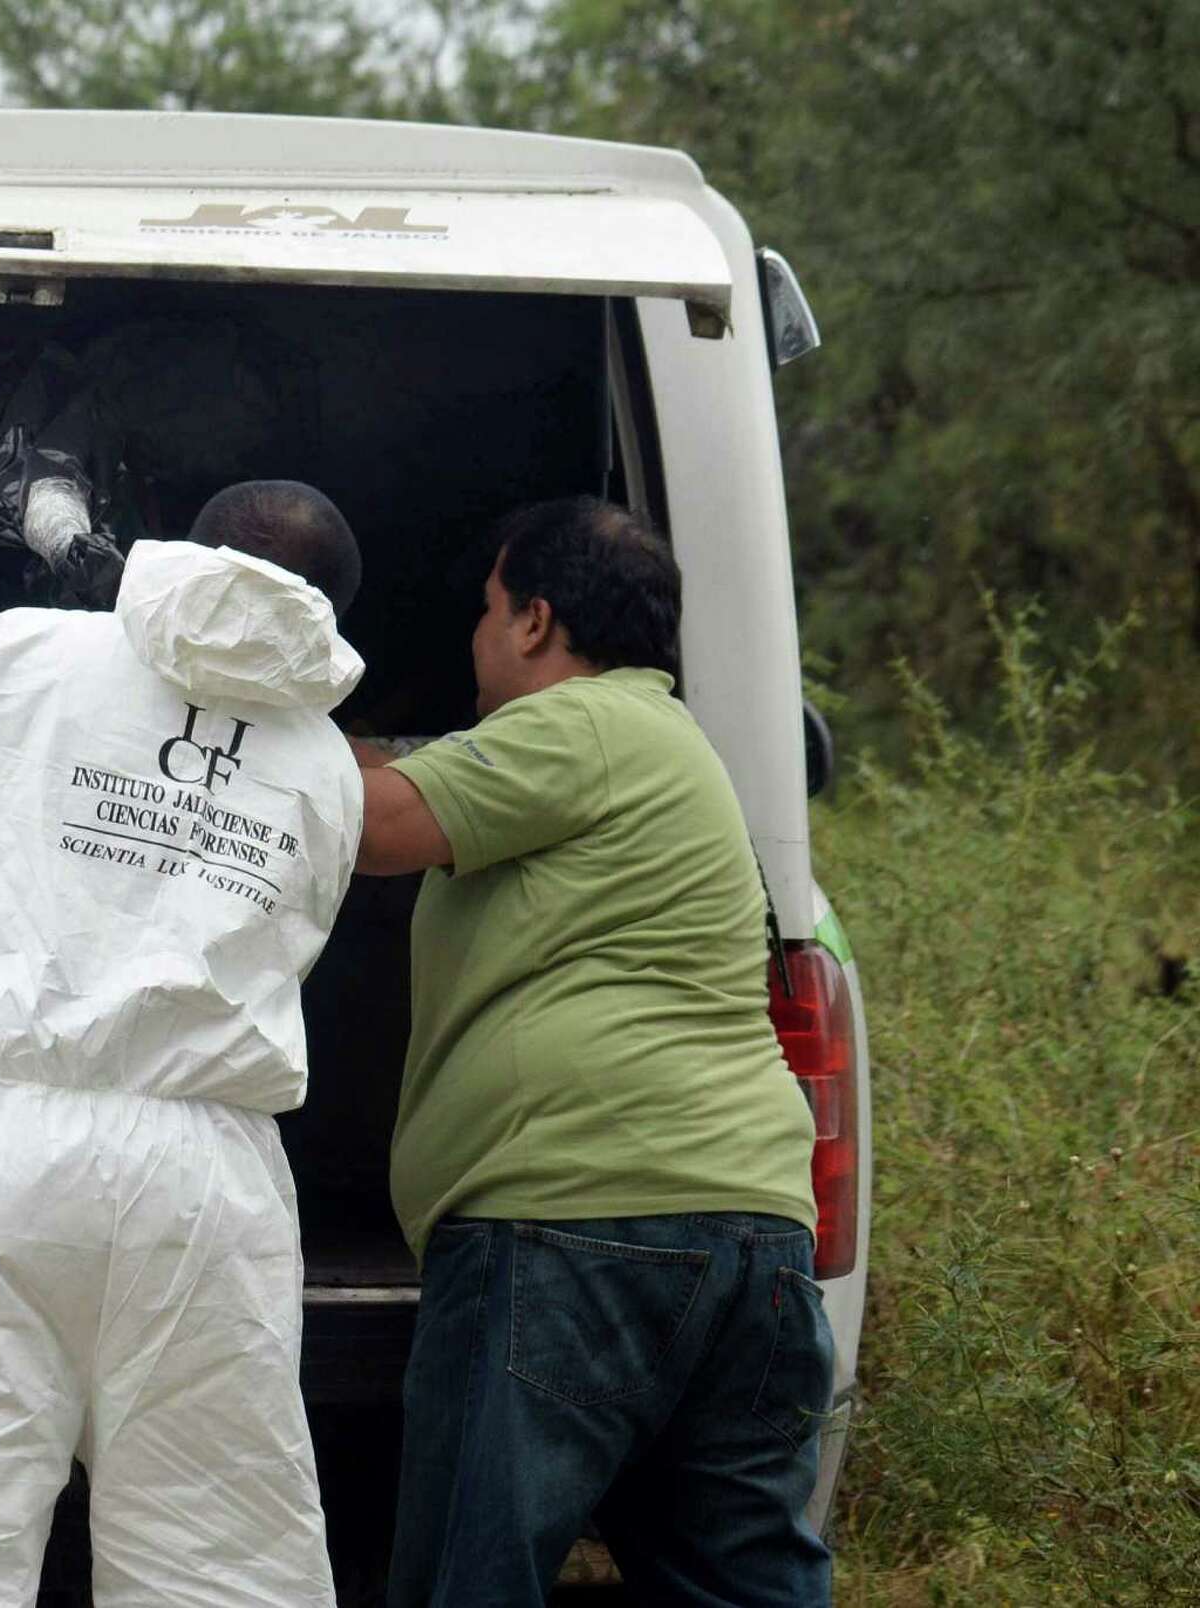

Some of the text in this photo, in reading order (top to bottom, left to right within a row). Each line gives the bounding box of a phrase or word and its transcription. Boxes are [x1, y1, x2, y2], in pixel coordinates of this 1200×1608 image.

[71, 765, 299, 859] INSTITUTO JALISCIENSE DE
[96, 799, 180, 838] CIENCIAS
[59, 835, 147, 869] SCIENTIA
